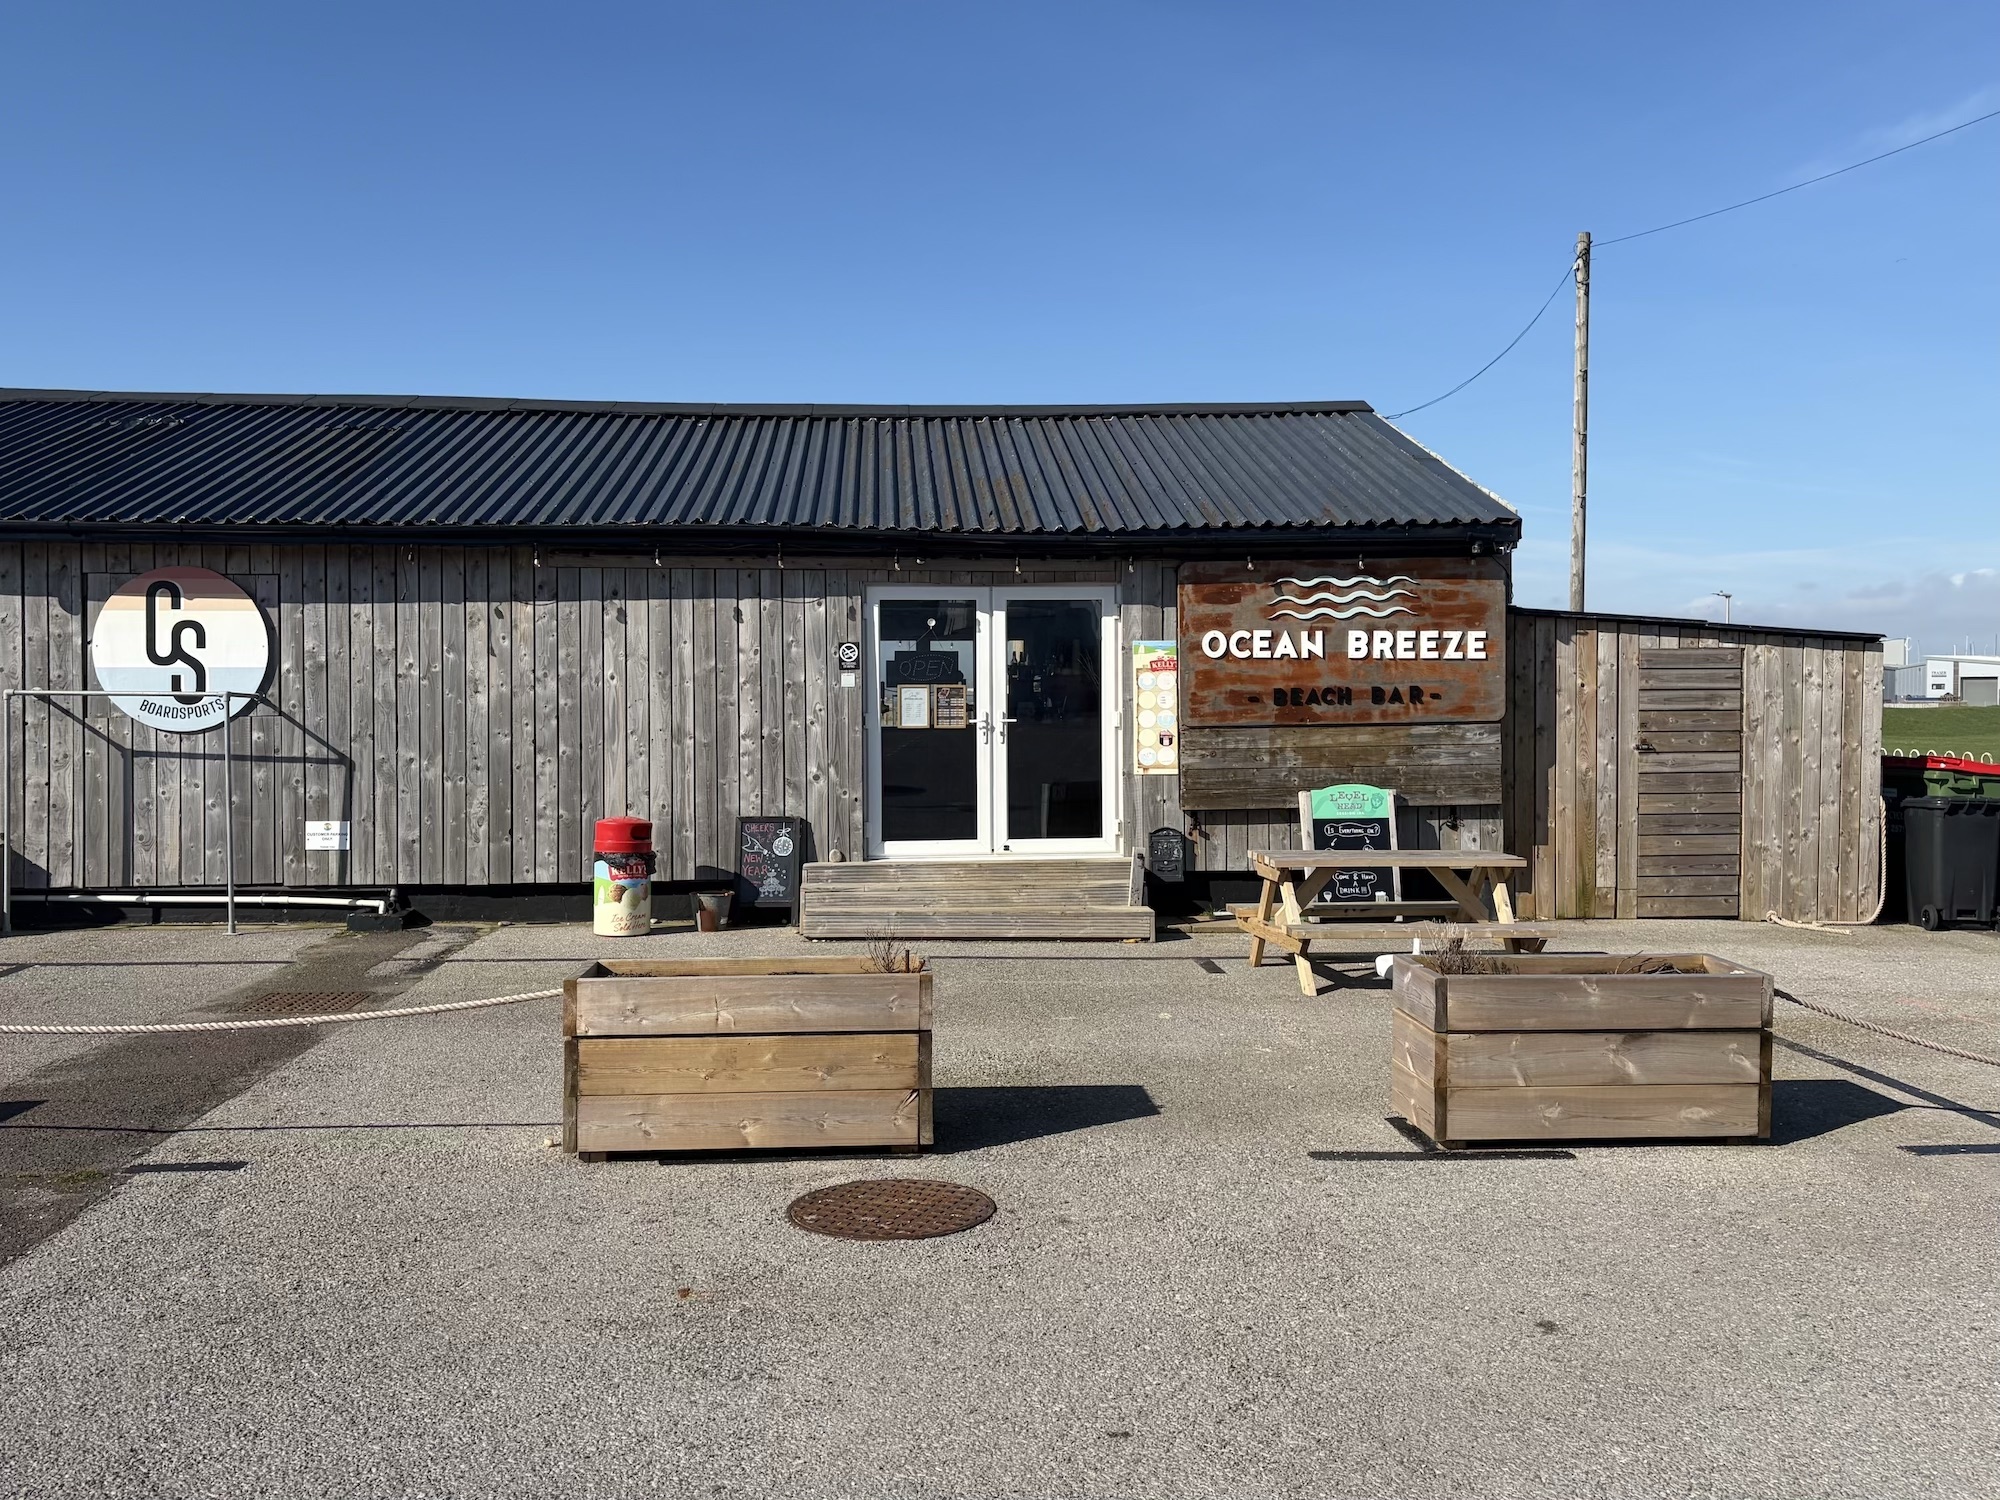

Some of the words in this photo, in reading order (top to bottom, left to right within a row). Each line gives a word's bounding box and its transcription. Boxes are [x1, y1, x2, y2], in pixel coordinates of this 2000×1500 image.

[1201, 629, 1325, 660] OCEAN
[1347, 630, 1488, 661] BREEZE
[900, 659, 954, 677] OPEN
[1273, 686, 1352, 707] BEACH
[1371, 685, 1425, 705] BAR
[139, 698, 225, 720] BOARDSPORTS
[1329, 791, 1369, 802] LEVEL
[743, 853, 763, 863] NEW
[742, 864, 768, 877] YEAR
[611, 913, 624, 923] Ice
[625, 912, 647, 921] Cream
